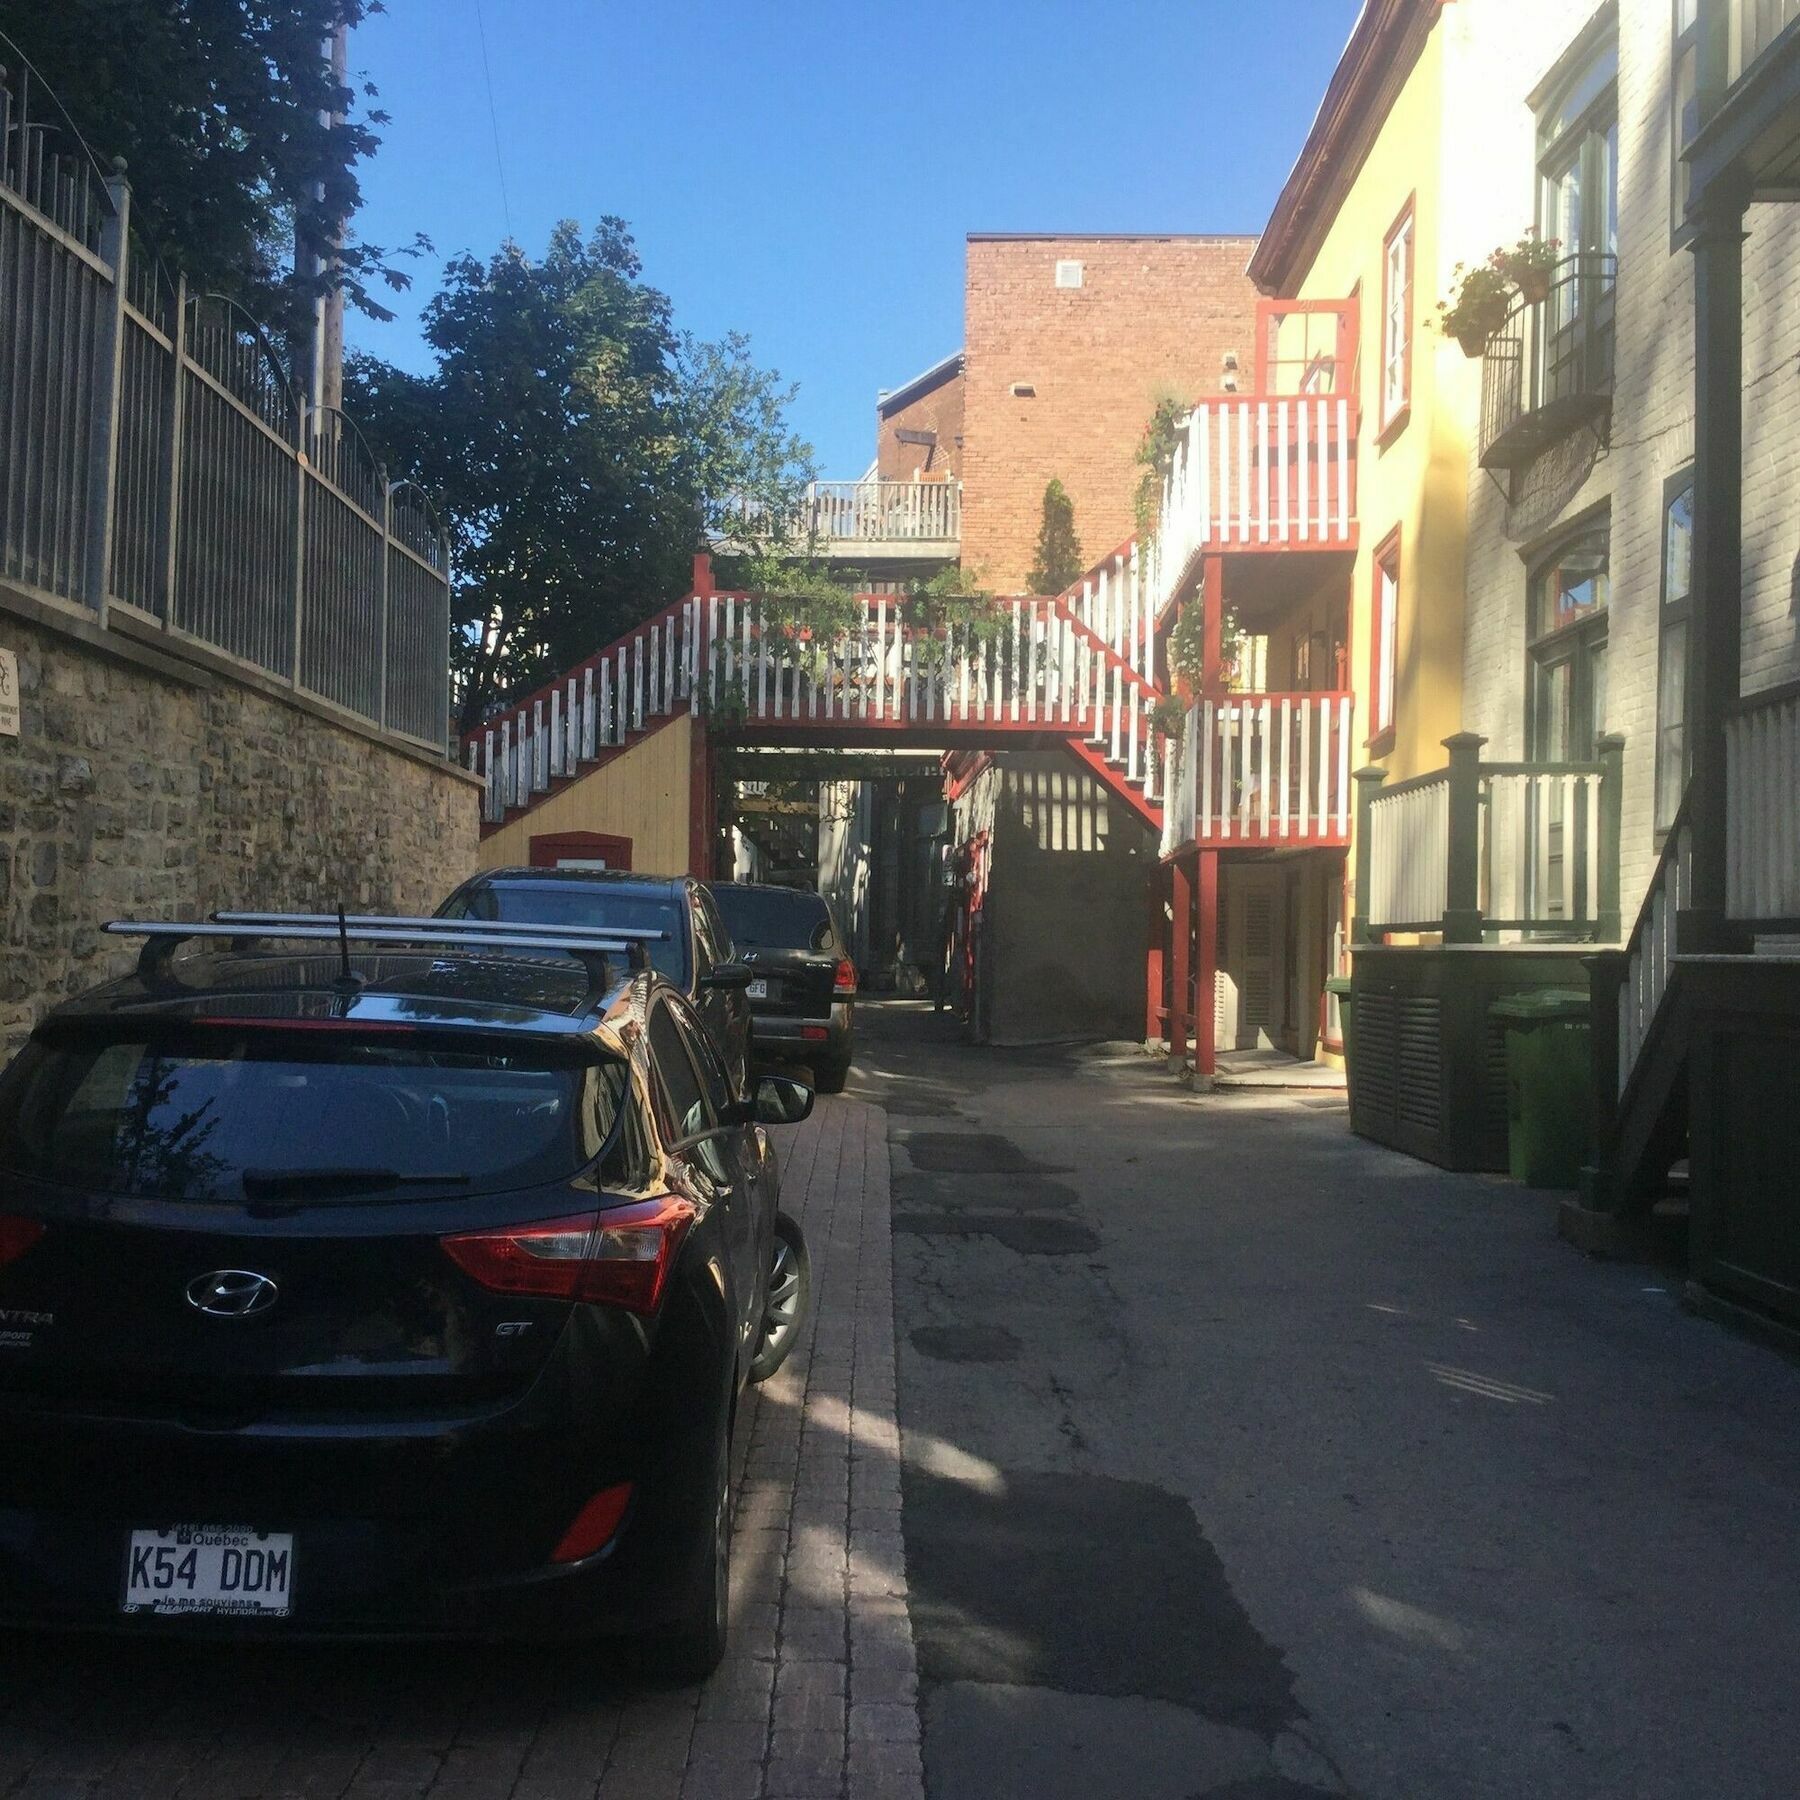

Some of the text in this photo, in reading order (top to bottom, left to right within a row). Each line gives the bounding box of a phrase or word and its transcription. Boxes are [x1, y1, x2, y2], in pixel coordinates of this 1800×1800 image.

[496, 1322, 533, 1336] GT
[131, 1546, 288, 1592] K54 DDM
[161, 1595, 175, 1605] Je
[178, 1597, 196, 1606] me
